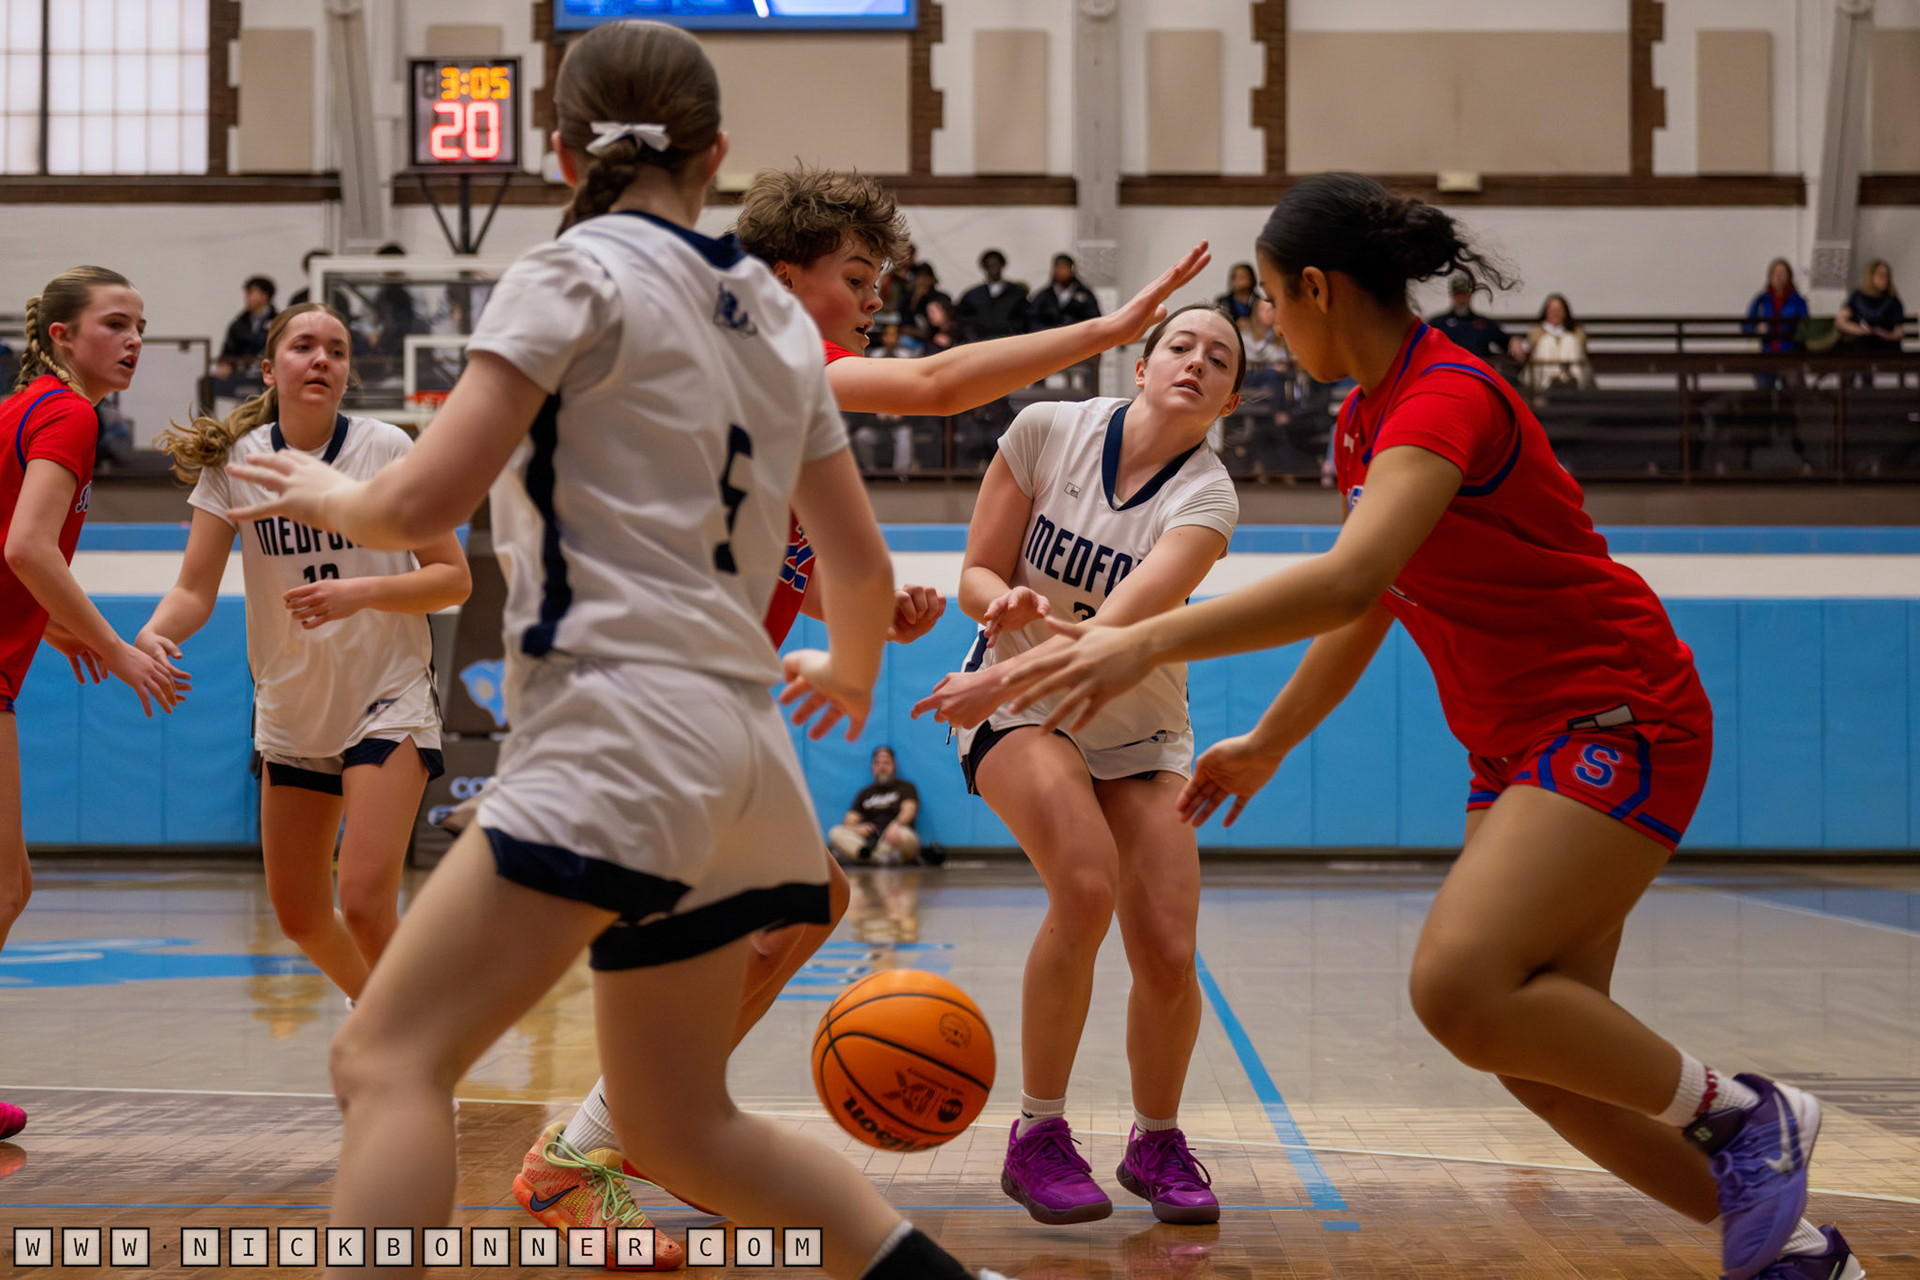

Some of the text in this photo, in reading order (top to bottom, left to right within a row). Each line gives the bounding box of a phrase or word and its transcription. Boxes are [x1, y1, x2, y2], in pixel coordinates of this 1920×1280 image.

[441, 66, 510, 100] 3:05
[430, 100, 501, 160] 20
[254, 516, 363, 556] MEDFO
[1025, 513, 1143, 598] MEDFO
[1573, 742, 1622, 789] S
